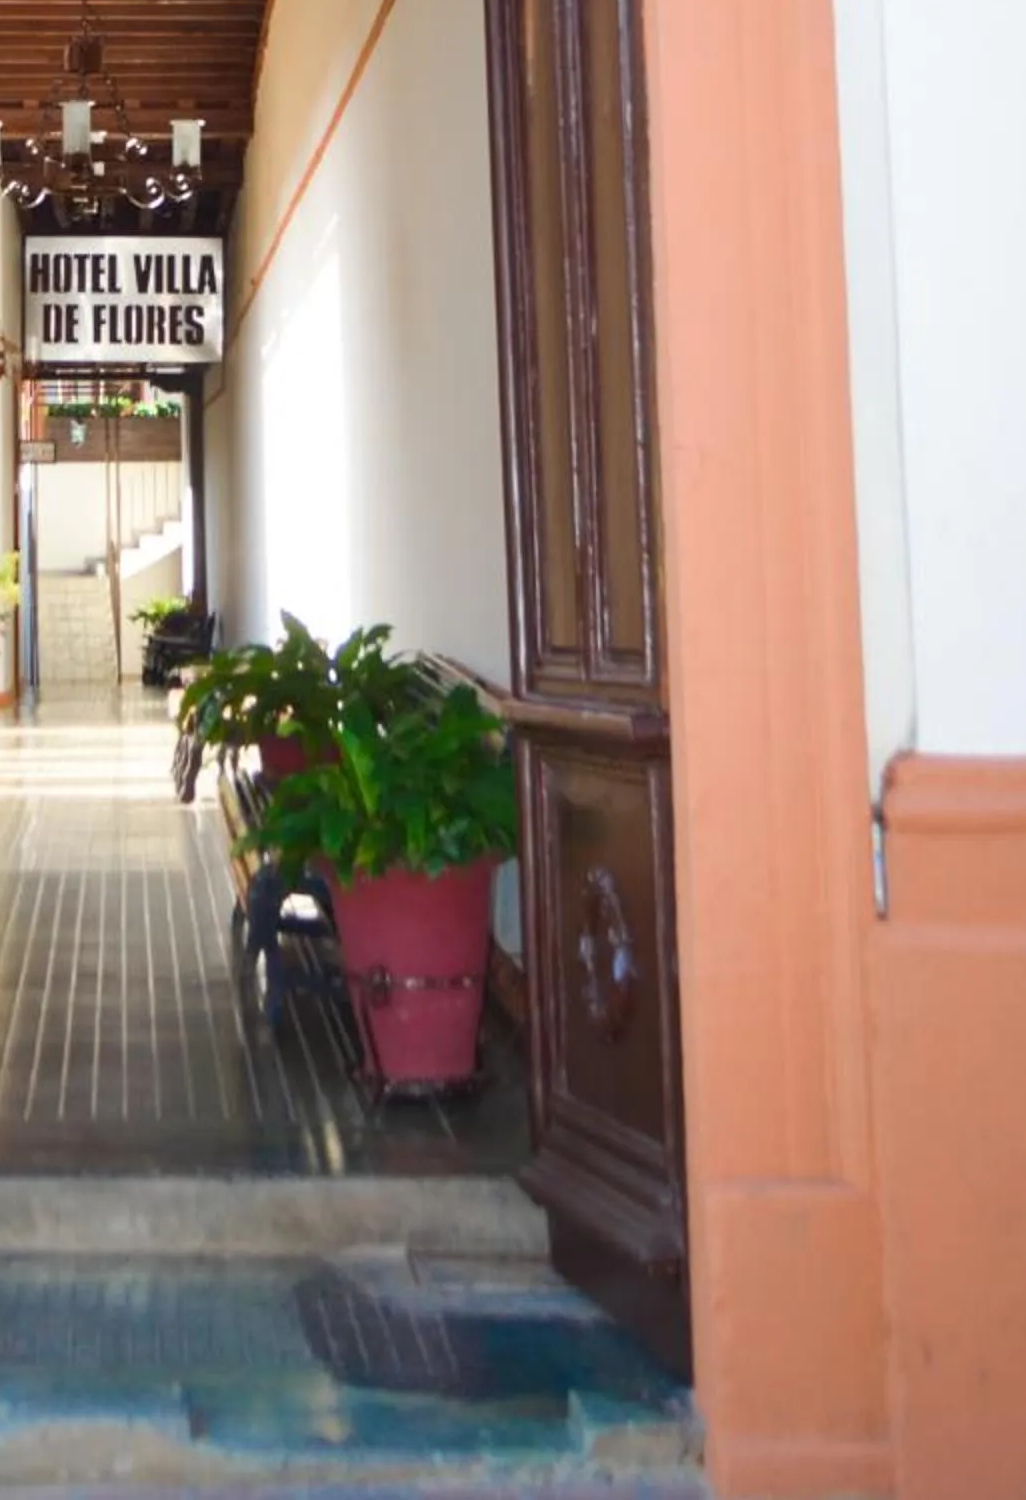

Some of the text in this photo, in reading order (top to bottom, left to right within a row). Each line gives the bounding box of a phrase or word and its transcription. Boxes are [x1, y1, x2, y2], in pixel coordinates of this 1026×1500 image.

[29, 253, 218, 294] HOTEL VILLA
[43, 304, 205, 345] DE FLORES
